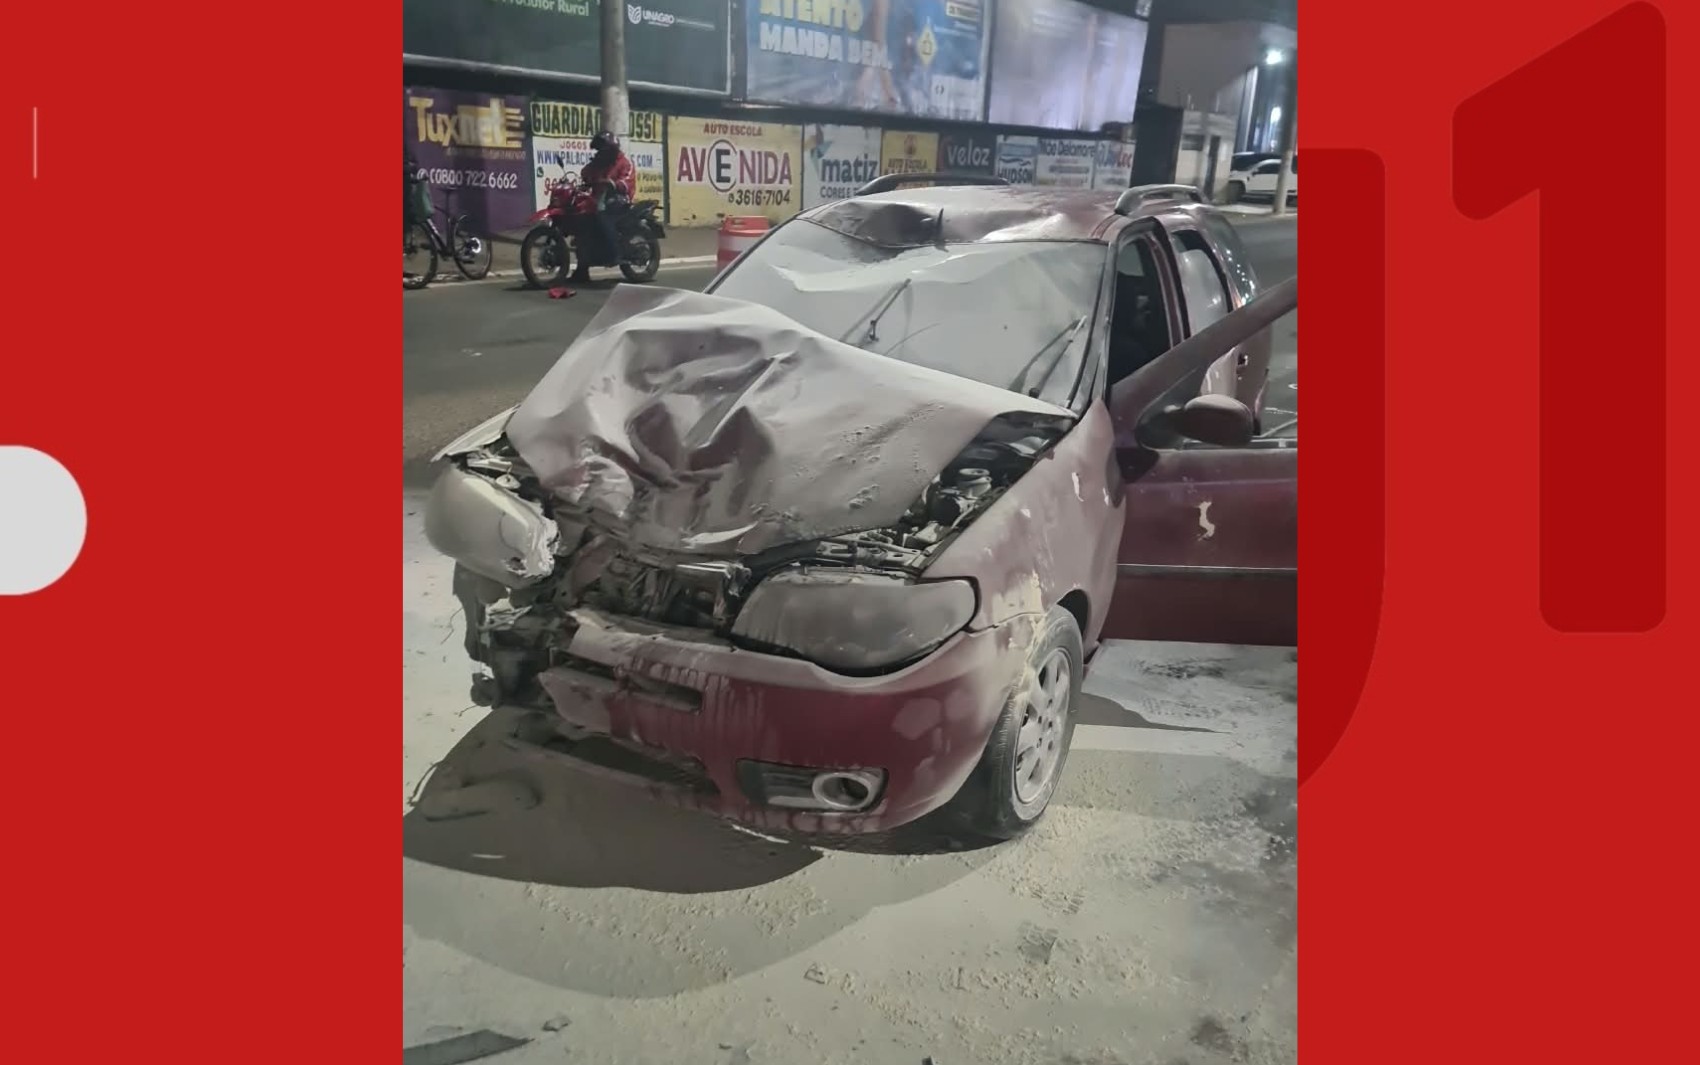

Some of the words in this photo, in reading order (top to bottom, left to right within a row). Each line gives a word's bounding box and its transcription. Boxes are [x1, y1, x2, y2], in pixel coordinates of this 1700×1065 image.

[558, 0, 589, 17] Rural
[759, 22, 843, 62] MANDA
[704, 123, 729, 135] AUTO
[730, 125, 763, 136] ESCOLA
[560, 141, 587, 150] JOGOS
[947, 139, 991, 166] veloz
[677, 146, 793, 185] AVENIDA
[821, 154, 878, 182] matiz
